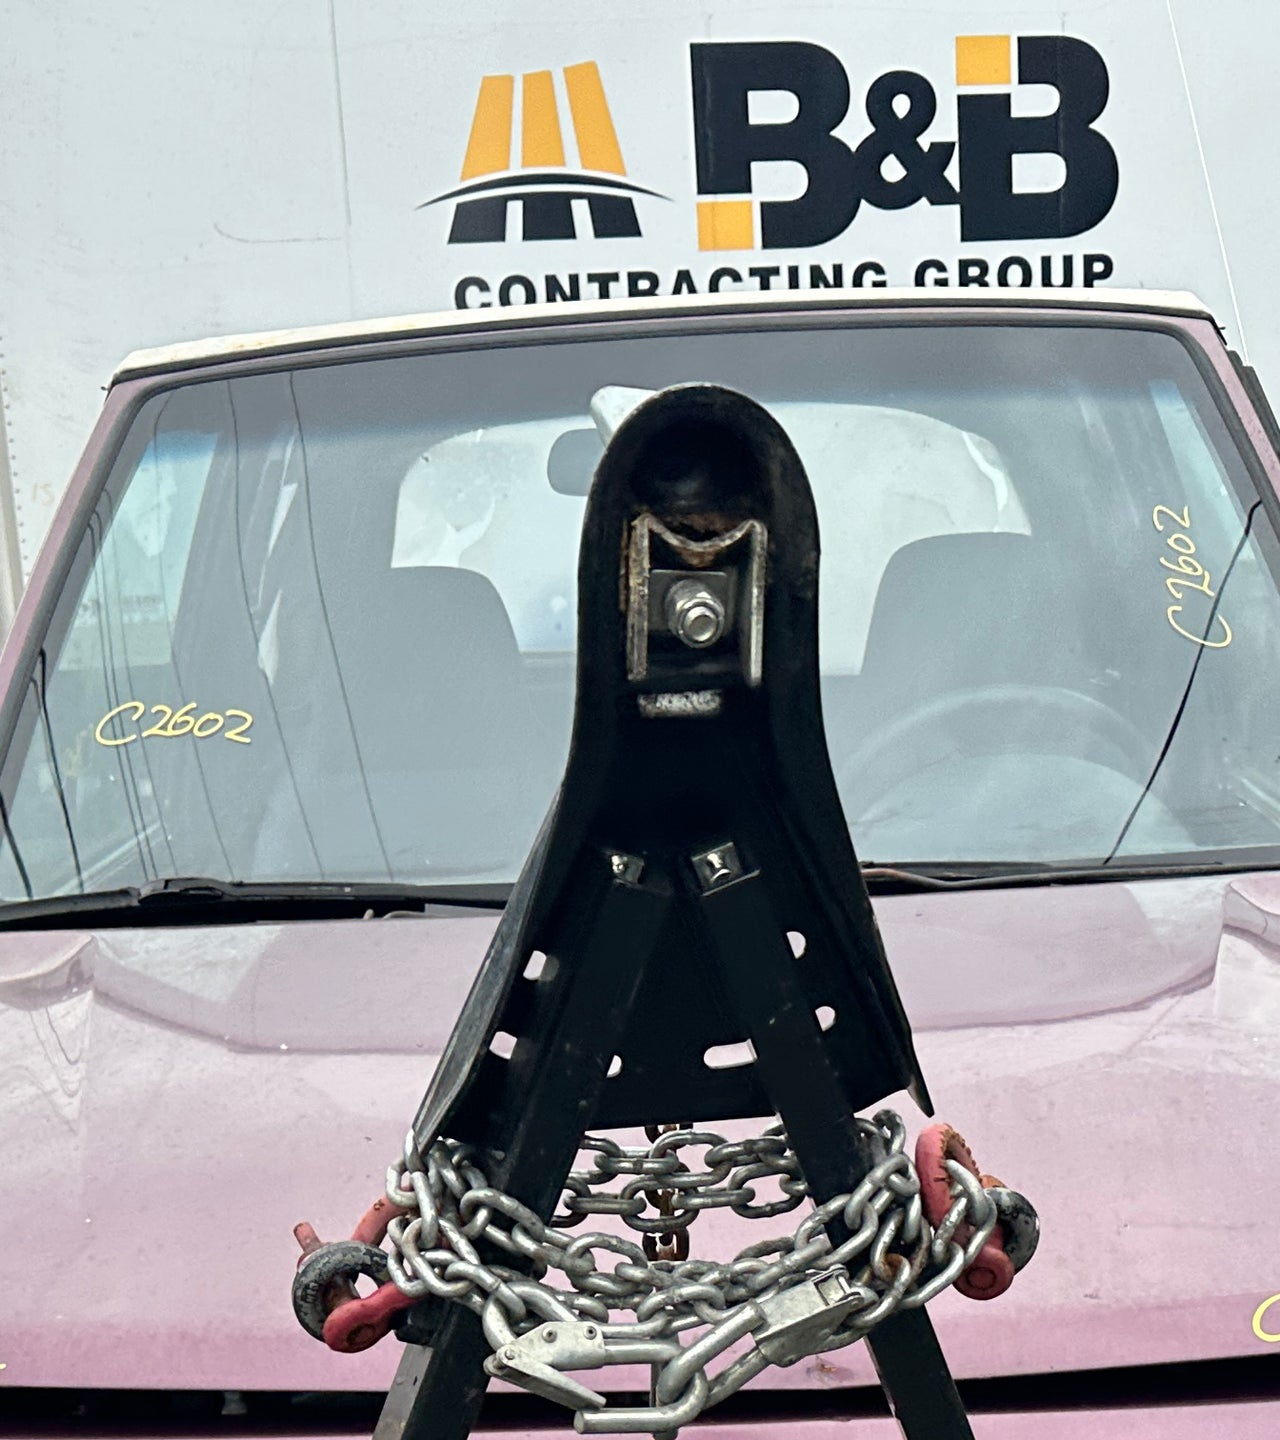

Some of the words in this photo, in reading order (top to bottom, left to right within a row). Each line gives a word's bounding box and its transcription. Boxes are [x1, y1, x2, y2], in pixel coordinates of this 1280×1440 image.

[690, 35, 1119, 251] B&B
[454, 261, 888, 310] CONTRACTING
[914, 253, 1114, 288] GROUP
[1152, 504, 1233, 648] C2602
[95, 700, 254, 746] C2602
